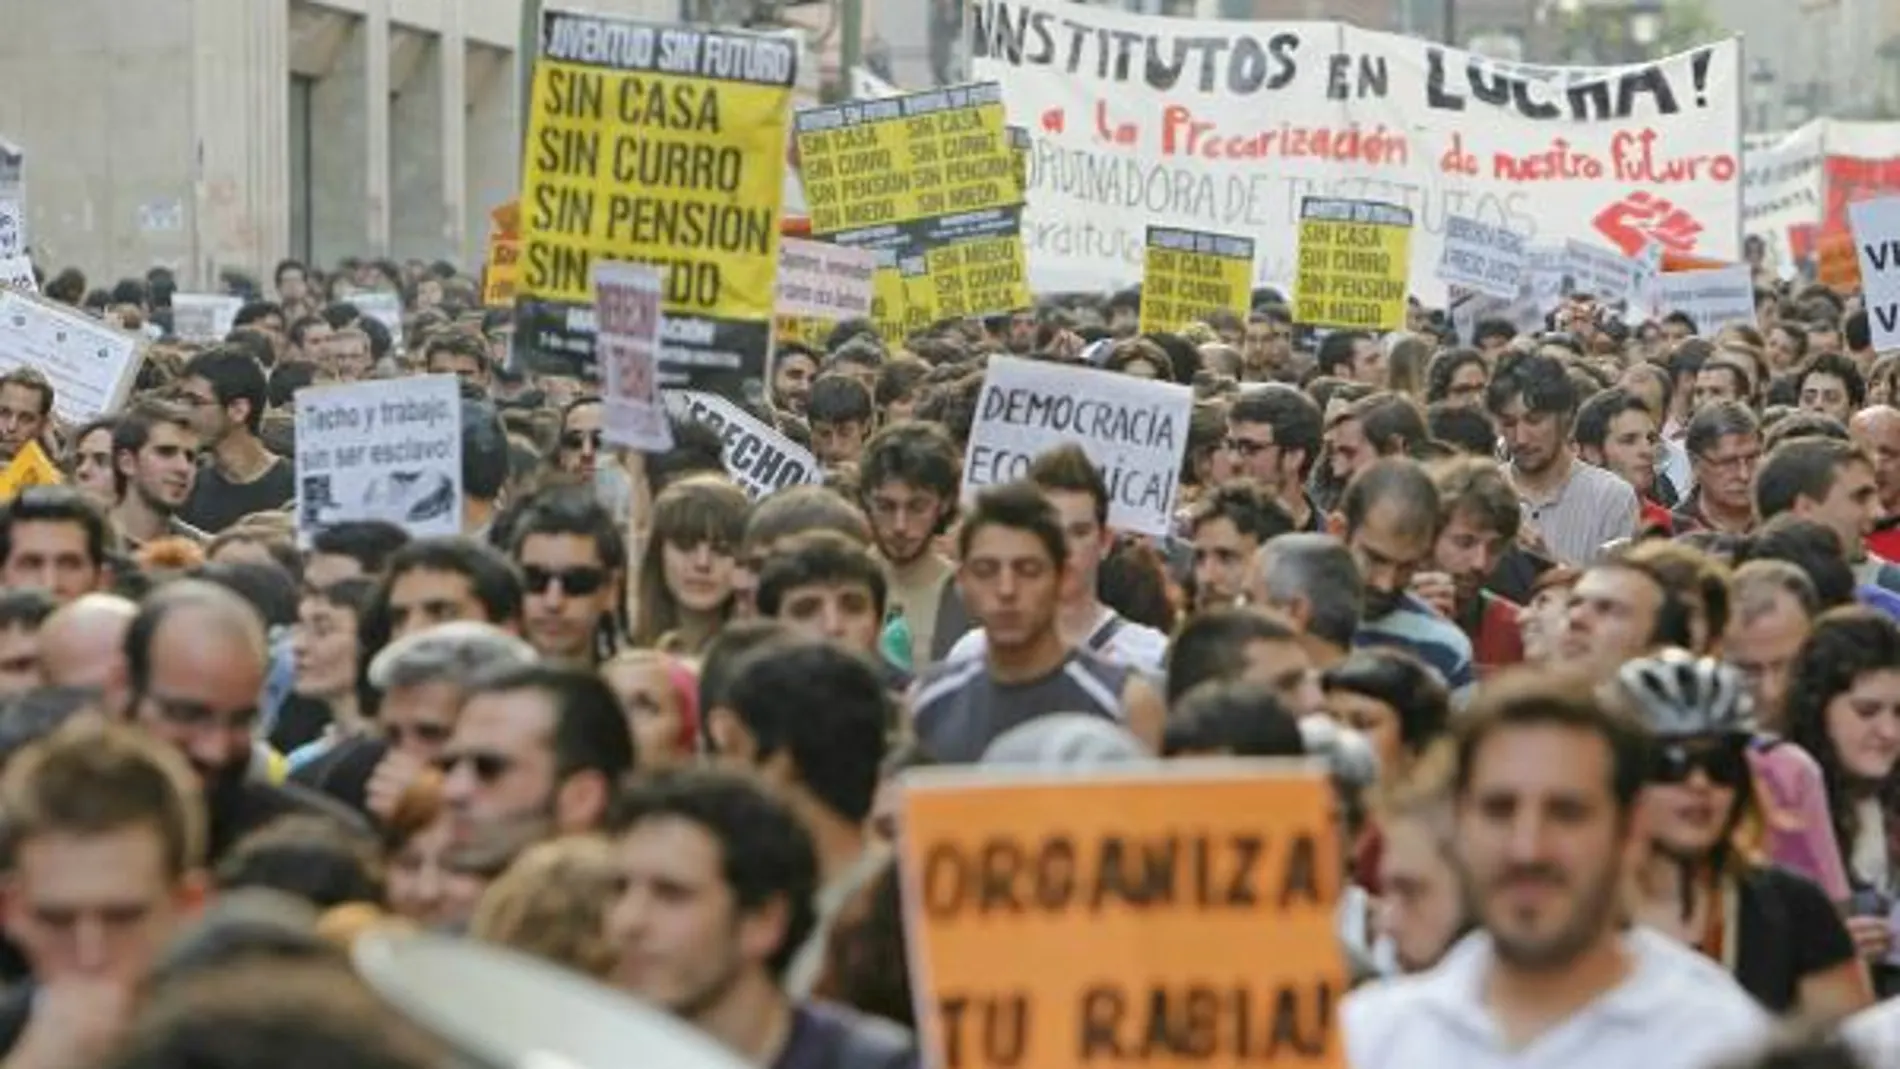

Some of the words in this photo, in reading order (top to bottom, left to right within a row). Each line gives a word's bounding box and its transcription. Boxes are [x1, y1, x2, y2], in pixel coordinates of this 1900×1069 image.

[659, 28, 699, 71] SIN
[704, 34, 792, 82] FUTURO
[1327, 53, 1389, 99] EN
[544, 69, 603, 118] SIN
[618, 76, 721, 134] CASA
[537, 125, 599, 178] SIN
[613, 135, 743, 193] CURRO
[1041, 107, 1064, 132] a
[1493, 137, 1603, 180] nuestro
[1610, 126, 1734, 183] futuro
[531, 183, 592, 235] SIN
[525, 240, 588, 292] SIN
[922, 832, 1322, 918] ORGANIZA
[938, 990, 1028, 1068] TU
[1079, 978, 1332, 1061] RABIA!
